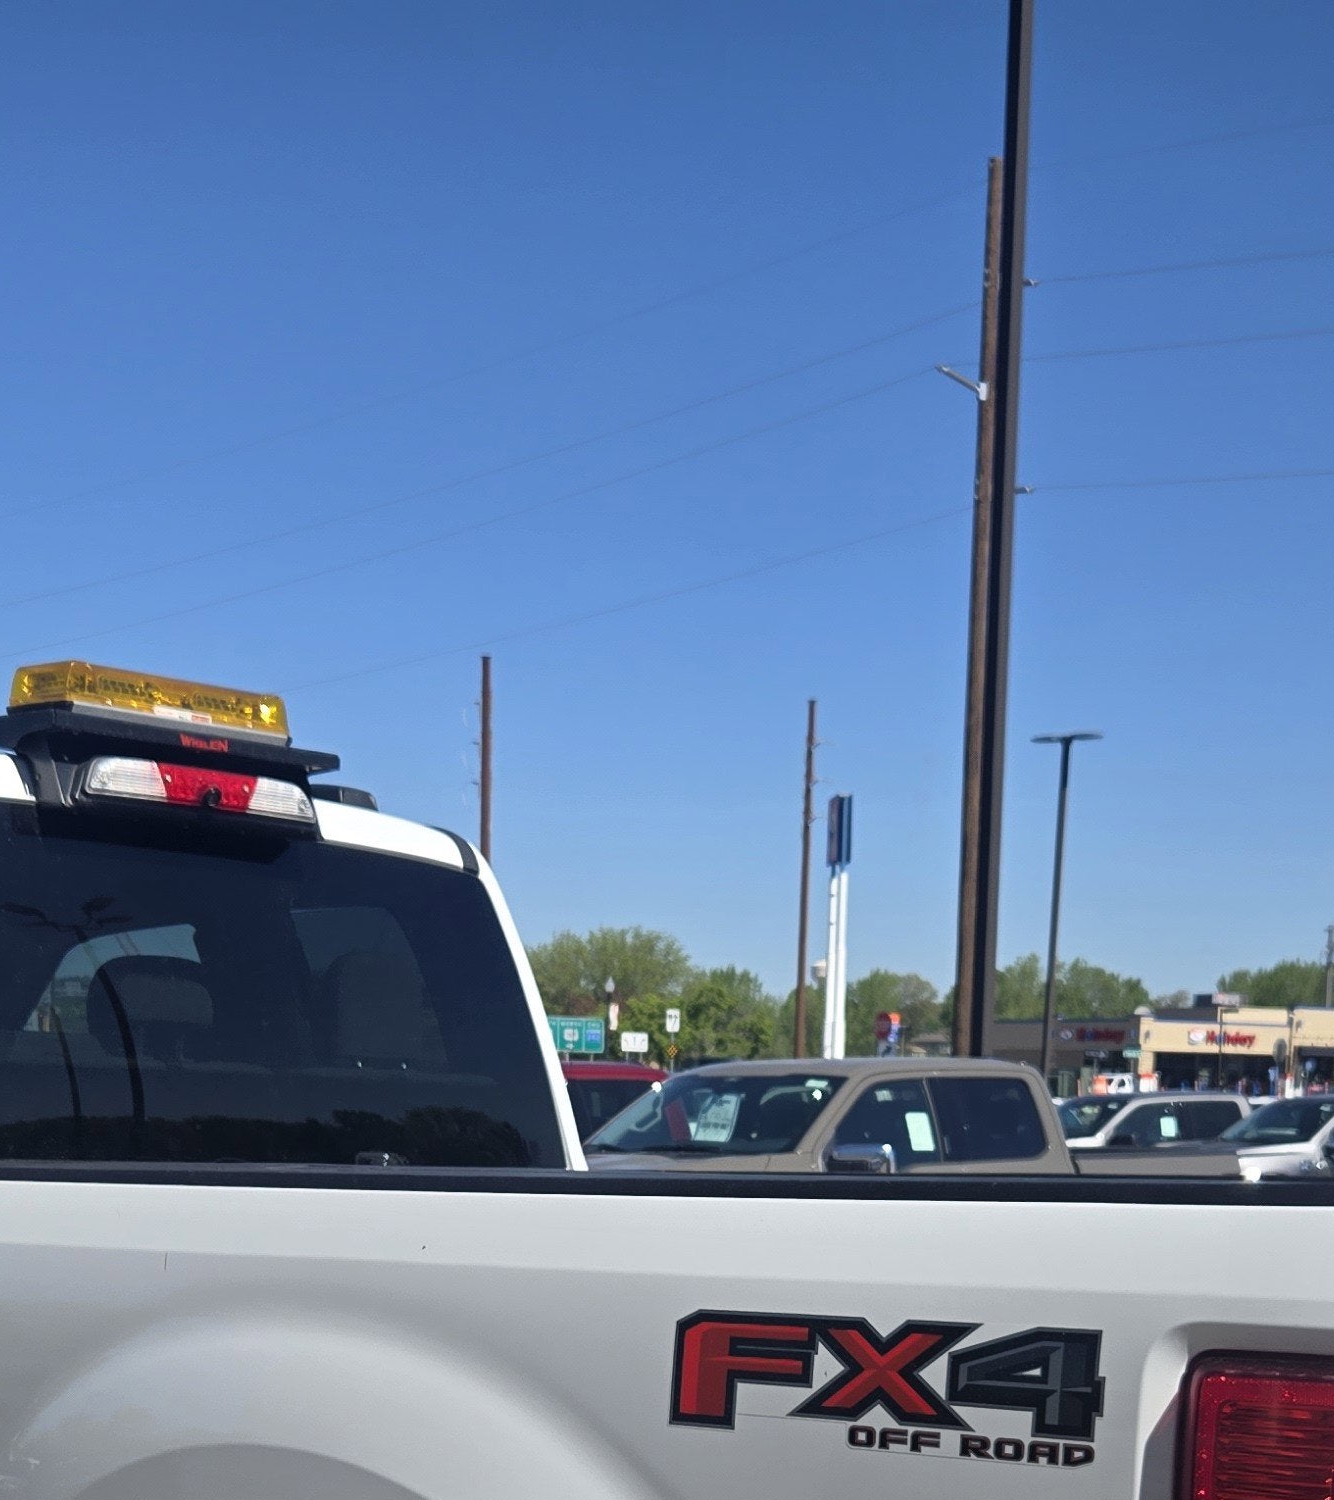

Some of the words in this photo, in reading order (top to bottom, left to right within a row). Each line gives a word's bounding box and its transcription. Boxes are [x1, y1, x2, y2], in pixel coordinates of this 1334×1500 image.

[669, 1308, 1105, 1442] FX4
[847, 1425, 941, 1453] OFF
[959, 1433, 1096, 1467] ROAD
